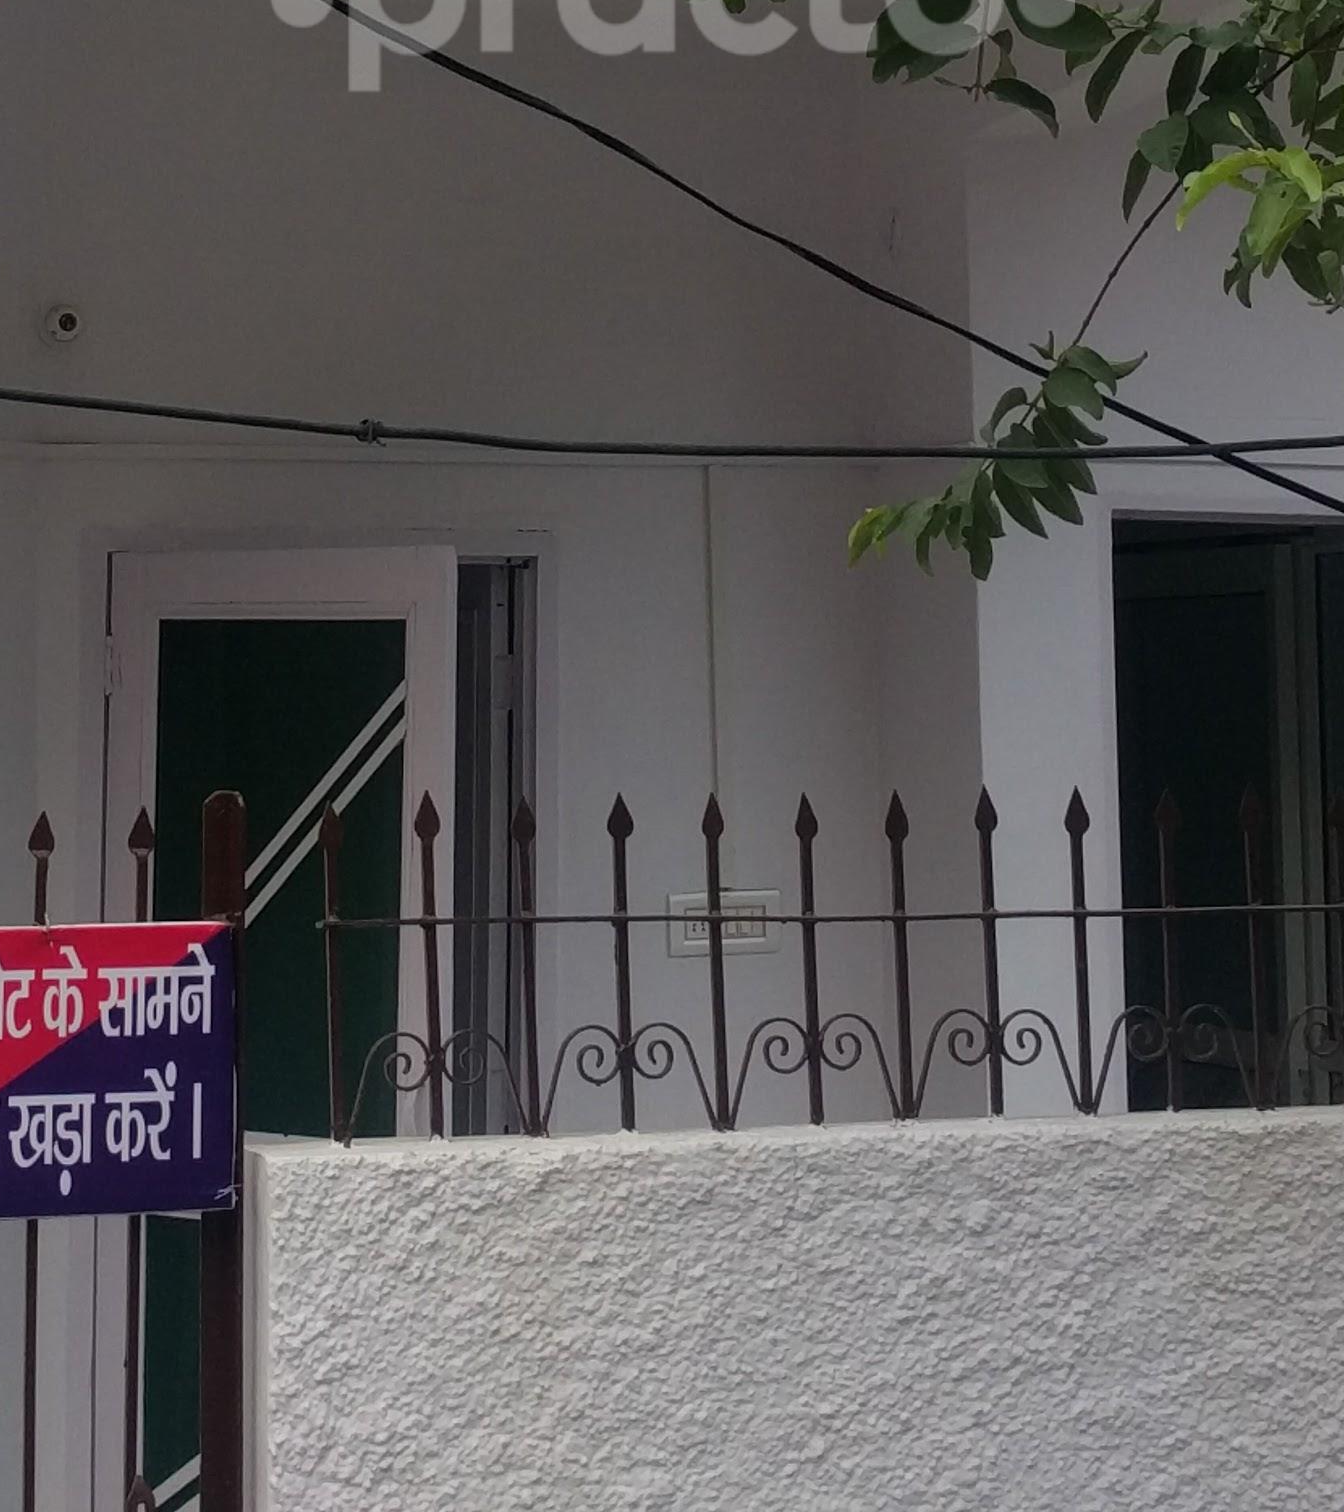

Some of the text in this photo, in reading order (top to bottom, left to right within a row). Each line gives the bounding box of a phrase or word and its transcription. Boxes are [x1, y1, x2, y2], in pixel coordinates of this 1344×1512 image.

[42, 945, 88, 1038] के
[97, 943, 216, 1036] सामने
[8, 1093, 95, 1196] खड़ा
[105, 1060, 177, 1162] करें
